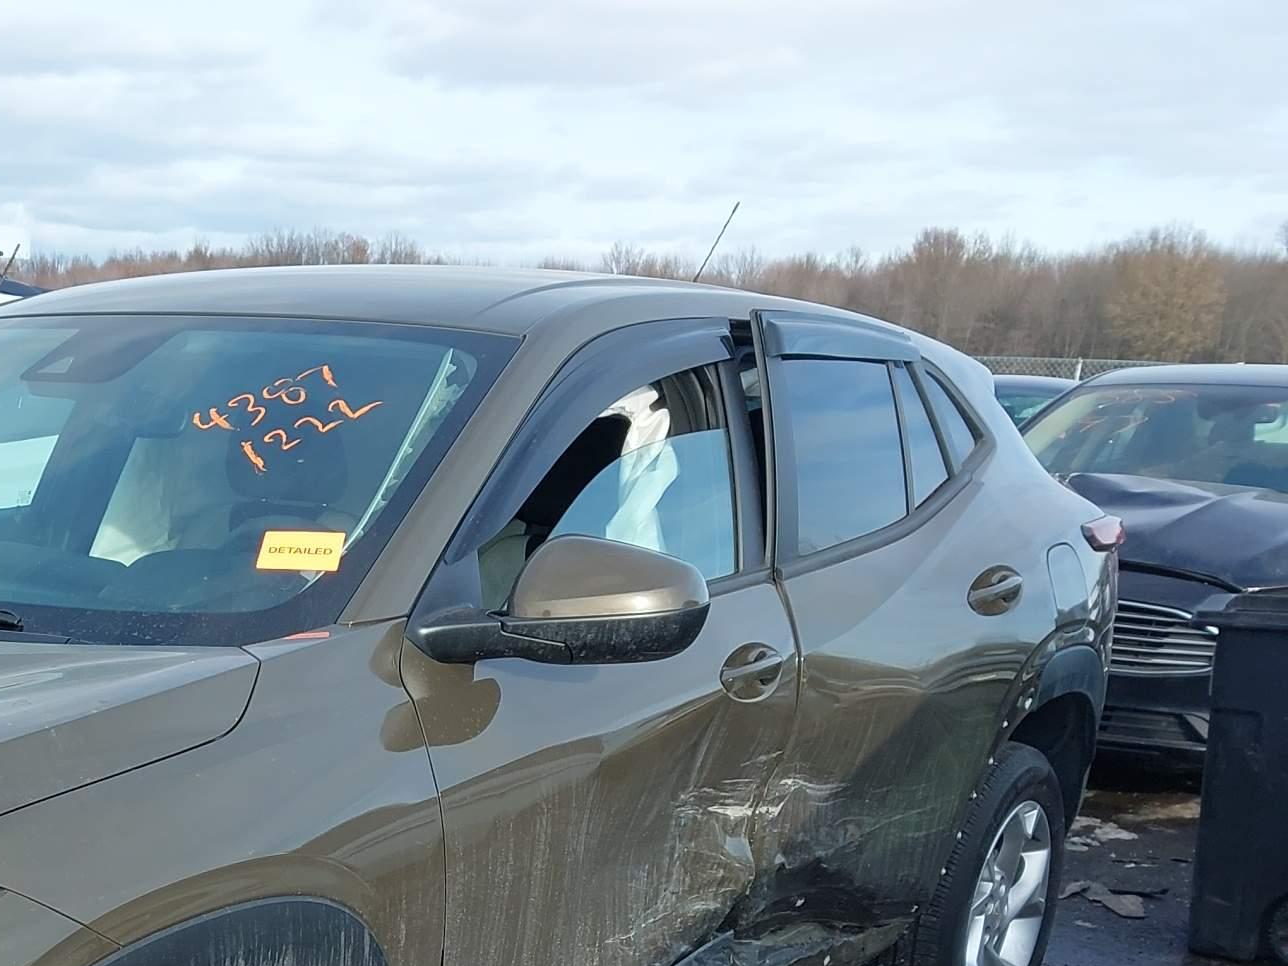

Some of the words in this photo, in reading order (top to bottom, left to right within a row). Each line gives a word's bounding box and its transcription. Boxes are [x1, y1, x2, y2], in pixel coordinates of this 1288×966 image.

[193, 363, 339, 431] 4387
[241, 399, 384, 475] 1222
[267, 545, 334, 556] DETAILED
